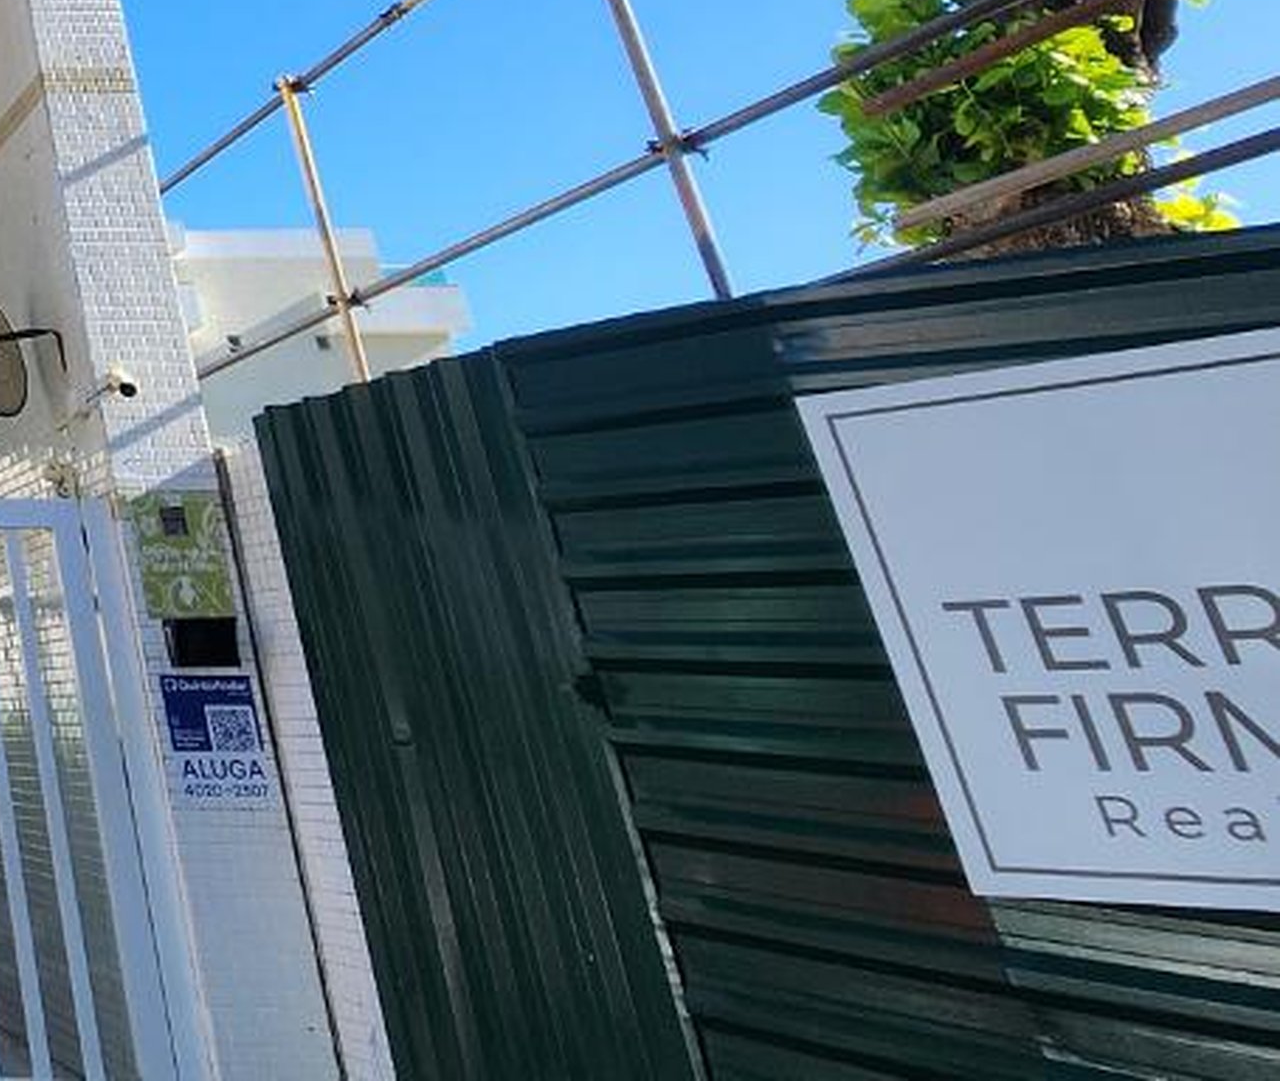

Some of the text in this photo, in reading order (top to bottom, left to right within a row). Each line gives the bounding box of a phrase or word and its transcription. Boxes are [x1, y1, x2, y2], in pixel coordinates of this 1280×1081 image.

[942, 584, 1280, 673] TERR
[183, 759, 267, 780] ALUGA
[1095, 794, 1280, 842] Rea
